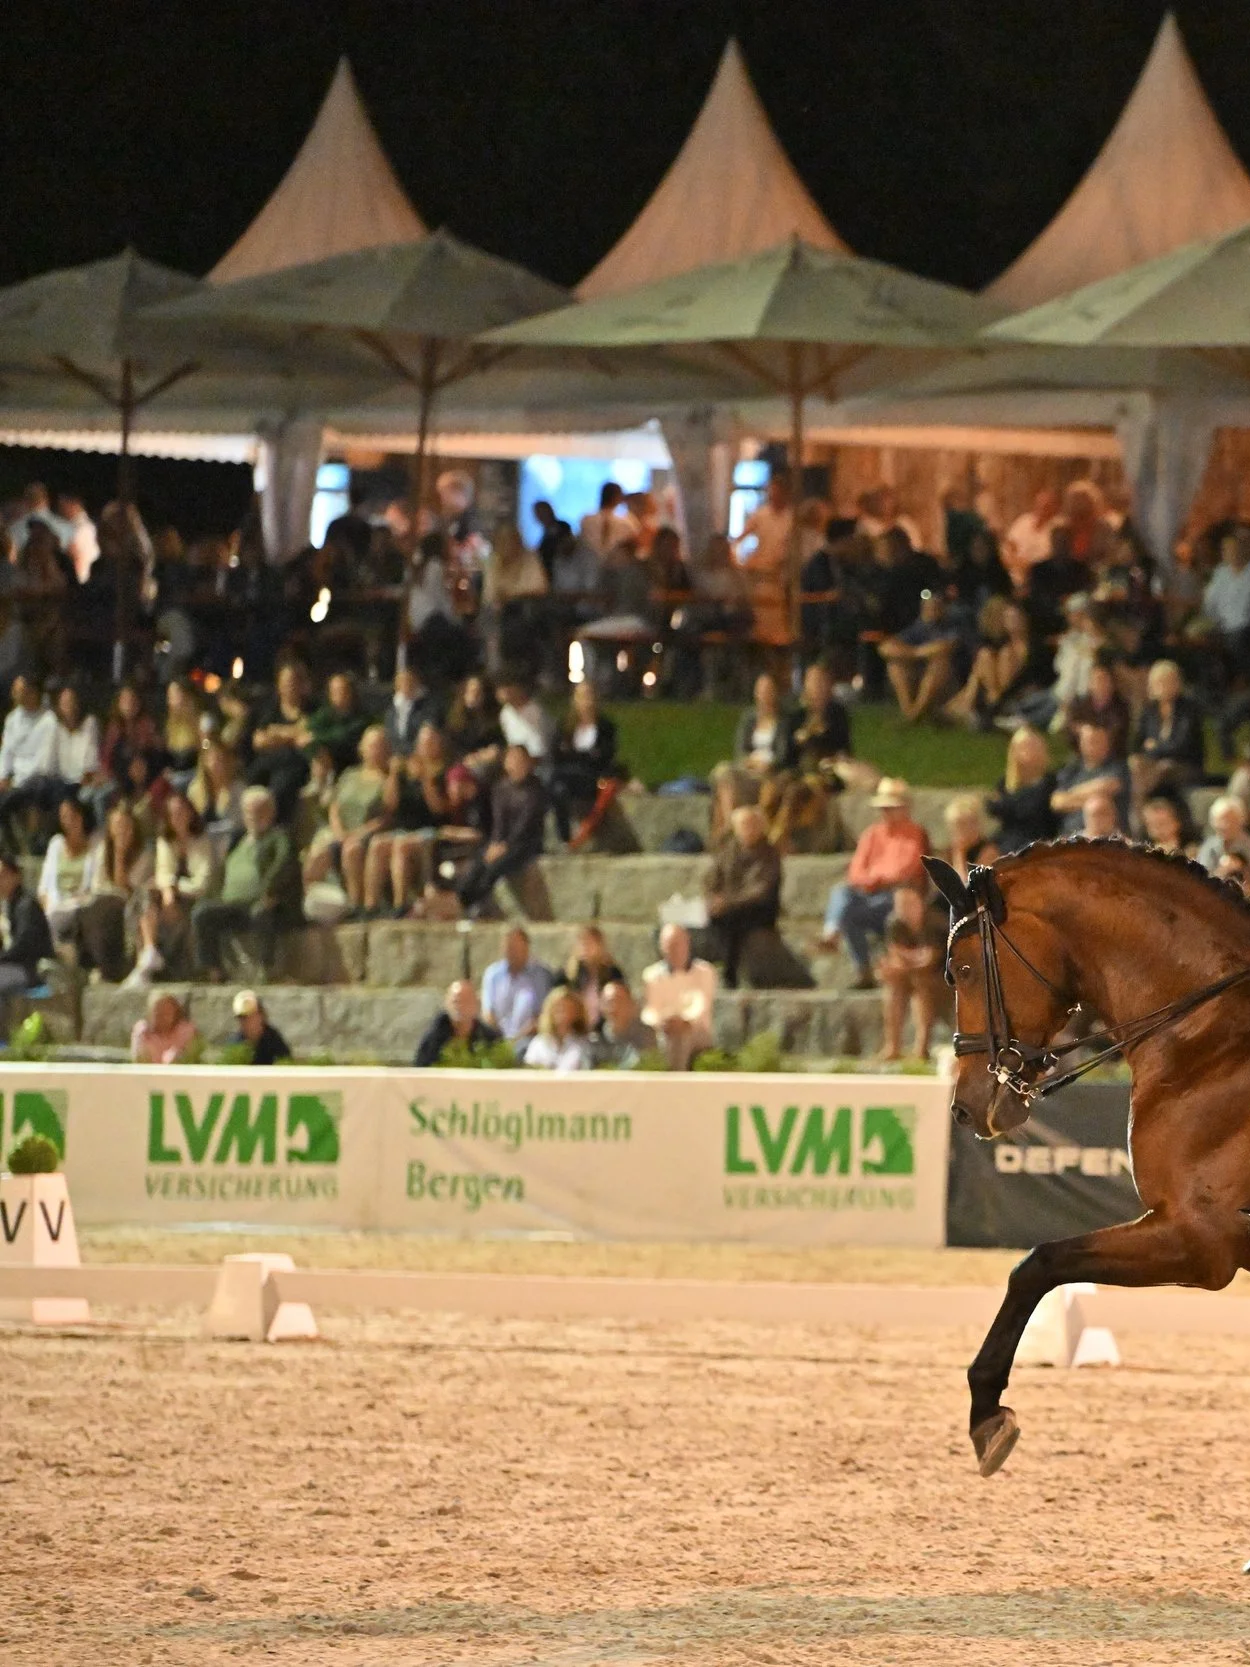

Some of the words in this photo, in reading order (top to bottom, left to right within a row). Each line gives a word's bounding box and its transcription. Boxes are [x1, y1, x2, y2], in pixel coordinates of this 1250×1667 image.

[147, 1091, 277, 1165] LVM
[409, 1097, 632, 1153] Schlöglmann
[725, 1105, 853, 1175] LVM
[145, 1172, 339, 1200] VERSICHERUNG
[406, 1159, 525, 1213] Bergen
[0, 1200, 27, 1243] V
[39, 1200, 66, 1242] V
